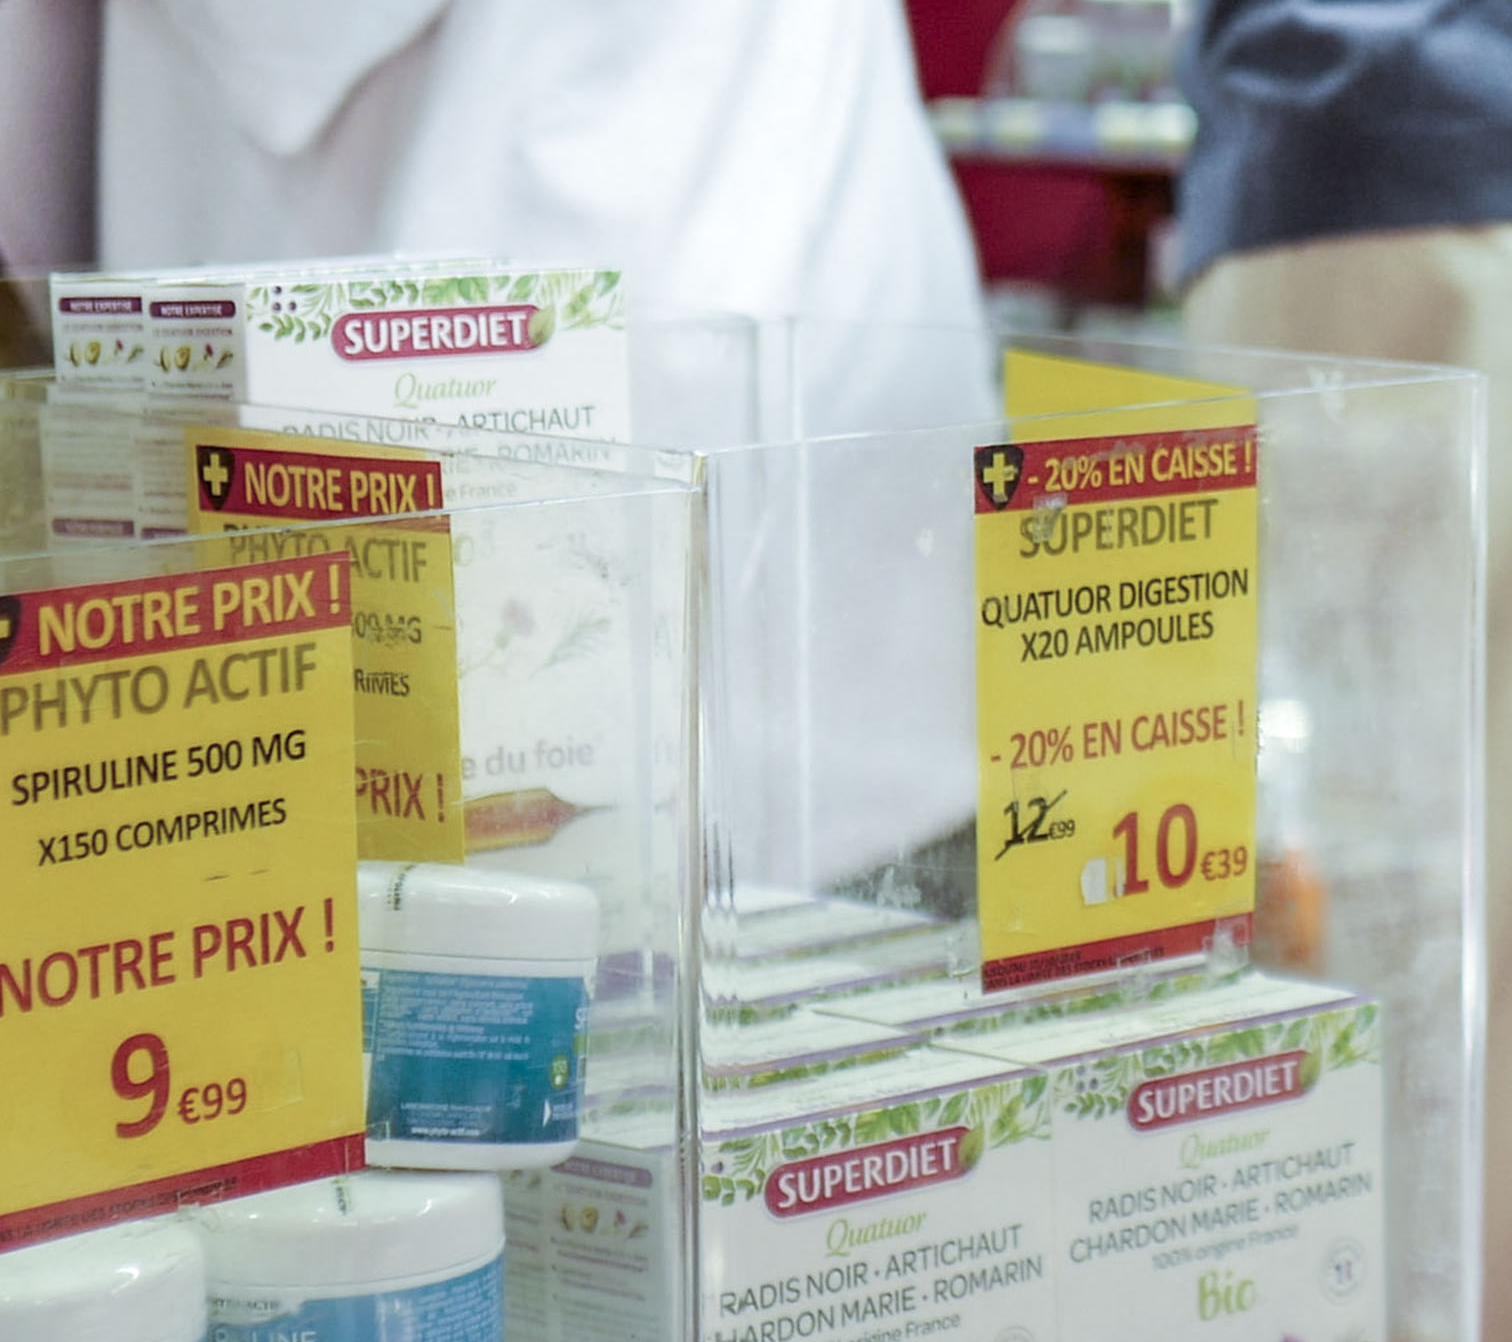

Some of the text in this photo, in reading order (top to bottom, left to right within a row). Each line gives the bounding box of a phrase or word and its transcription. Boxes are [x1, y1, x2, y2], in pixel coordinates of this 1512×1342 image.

[343, 307, 529, 355] SUPERDIET
[394, 371, 498, 409] Quatuor
[243, 462, 343, 512] NOTRE
[348, 469, 418, 516] PRIX
[1108, 451, 1147, 487] EN
[1150, 443, 1239, 482] CAISSE
[345, 535, 428, 584] ACTIF
[1019, 497, 1220, 560] SUPERDIET
[37, 565, 343, 657] NOTRE PRIX !
[980, 567, 1251, 629] QUATUOR DIGESTION
[1020, 610, 1216, 663] X20 AMPOULES
[182, 640, 319, 710] ACTIF
[353, 667, 411, 698] RIMES
[484, 738, 595, 777] du foie
[1082, 717, 1123, 762] EN
[1130, 703, 1229, 752] CAISSE
[10, 728, 308, 808] SPIRULINE 500 MG
[37, 797, 288, 867] X150 COMPRIMES
[191, 904, 309, 982] PRIX
[321, 897, 337, 953] !
[1135, 1059, 1300, 1124] SUPERDIET
[776, 1136, 959, 1211] SUPERDIET
[1178, 1123, 1274, 1170] Quatuor
[1089, 1139, 1356, 1226] RADIS NOIR ARTICHAUT
[825, 1208, 928, 1259] Quatuor
[1068, 1170, 1374, 1267] CHARDON MARIE ROMARIN
[718, 1223, 1023, 1320] RADIS NOIR ARTICHAUT
[840, 1286, 916, 1330] MARIE
[933, 1255, 1045, 1304] ROMARIN
[1196, 1270, 1258, 1323] Bio
